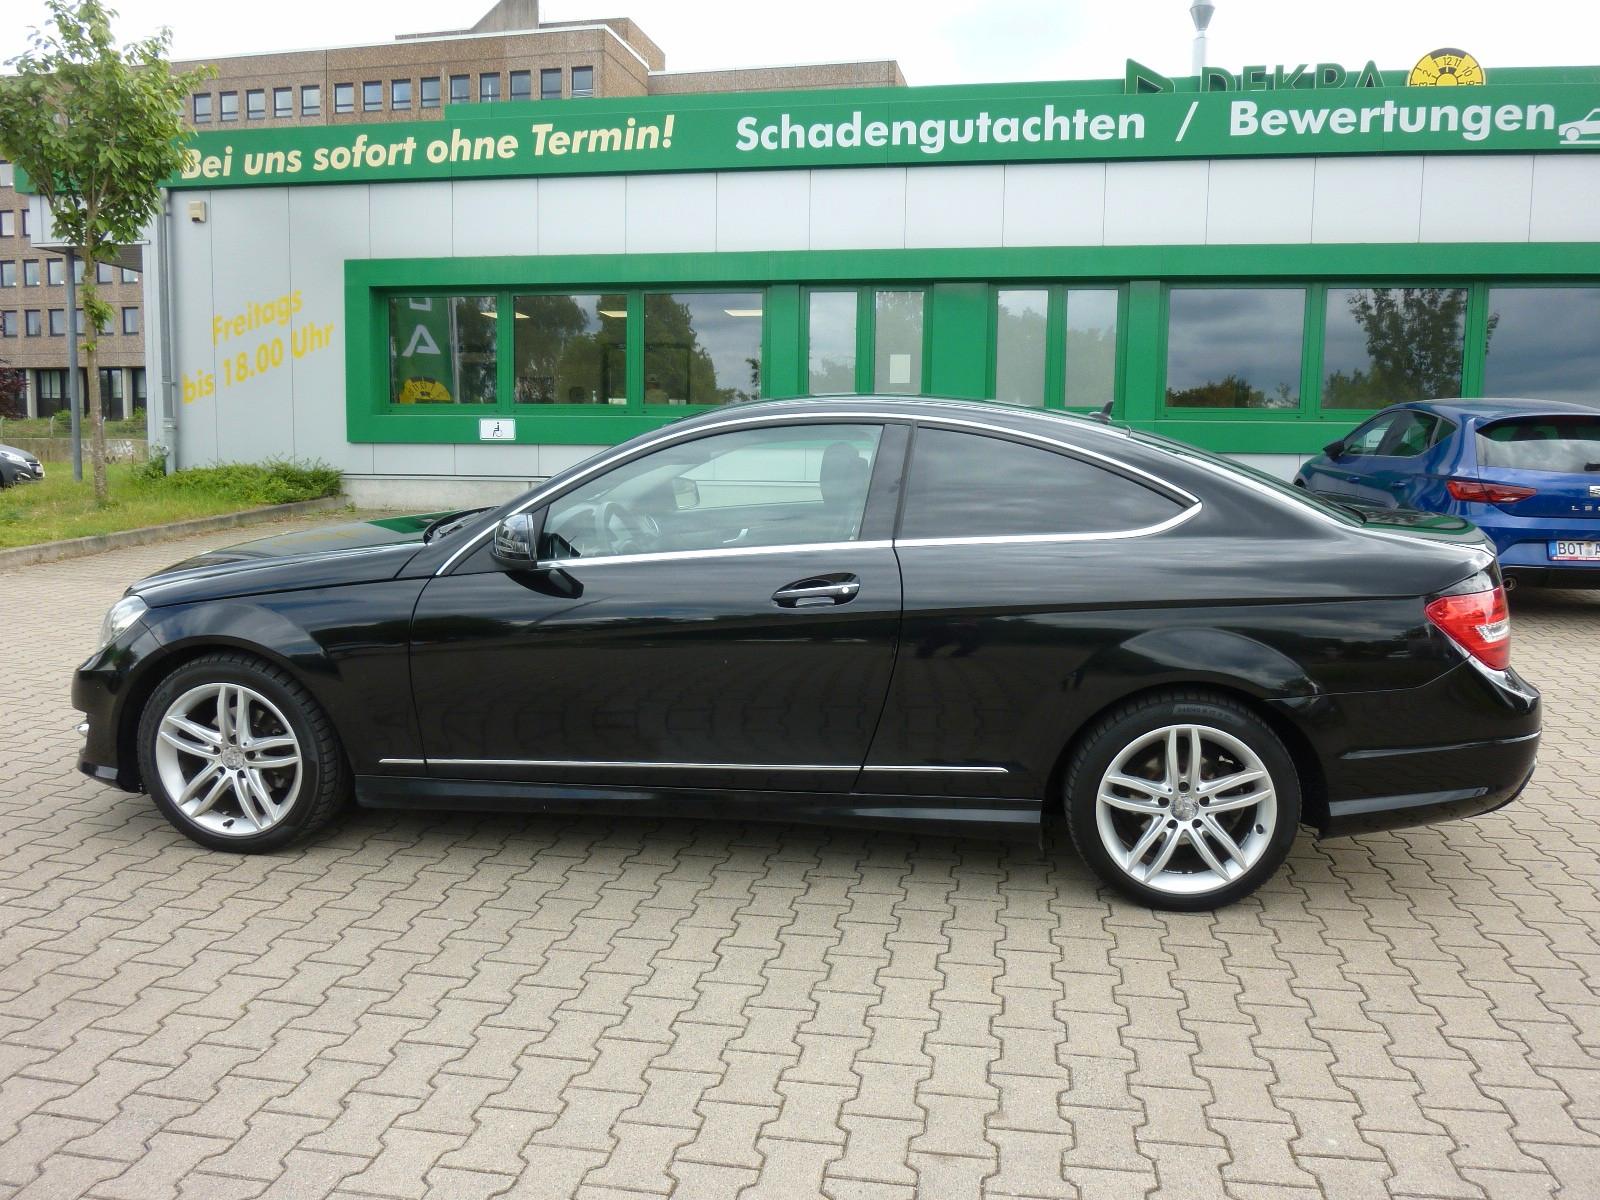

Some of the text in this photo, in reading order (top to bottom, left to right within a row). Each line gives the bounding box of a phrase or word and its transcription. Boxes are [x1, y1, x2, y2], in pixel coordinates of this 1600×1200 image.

[1443, 57, 1452, 66] 12
[1454, 58, 1462, 67] 11
[1462, 66, 1473, 77] 10
[181, 114, 675, 180] Bei uns sofort ohne Termin!
[735, 100, 1556, 154] Schadengutachten / Bewertungen
[212, 290, 304, 348] Freitags
[181, 321, 335, 404] bis 18.00 Uhr
[1558, 542, 1584, 555] BOT
